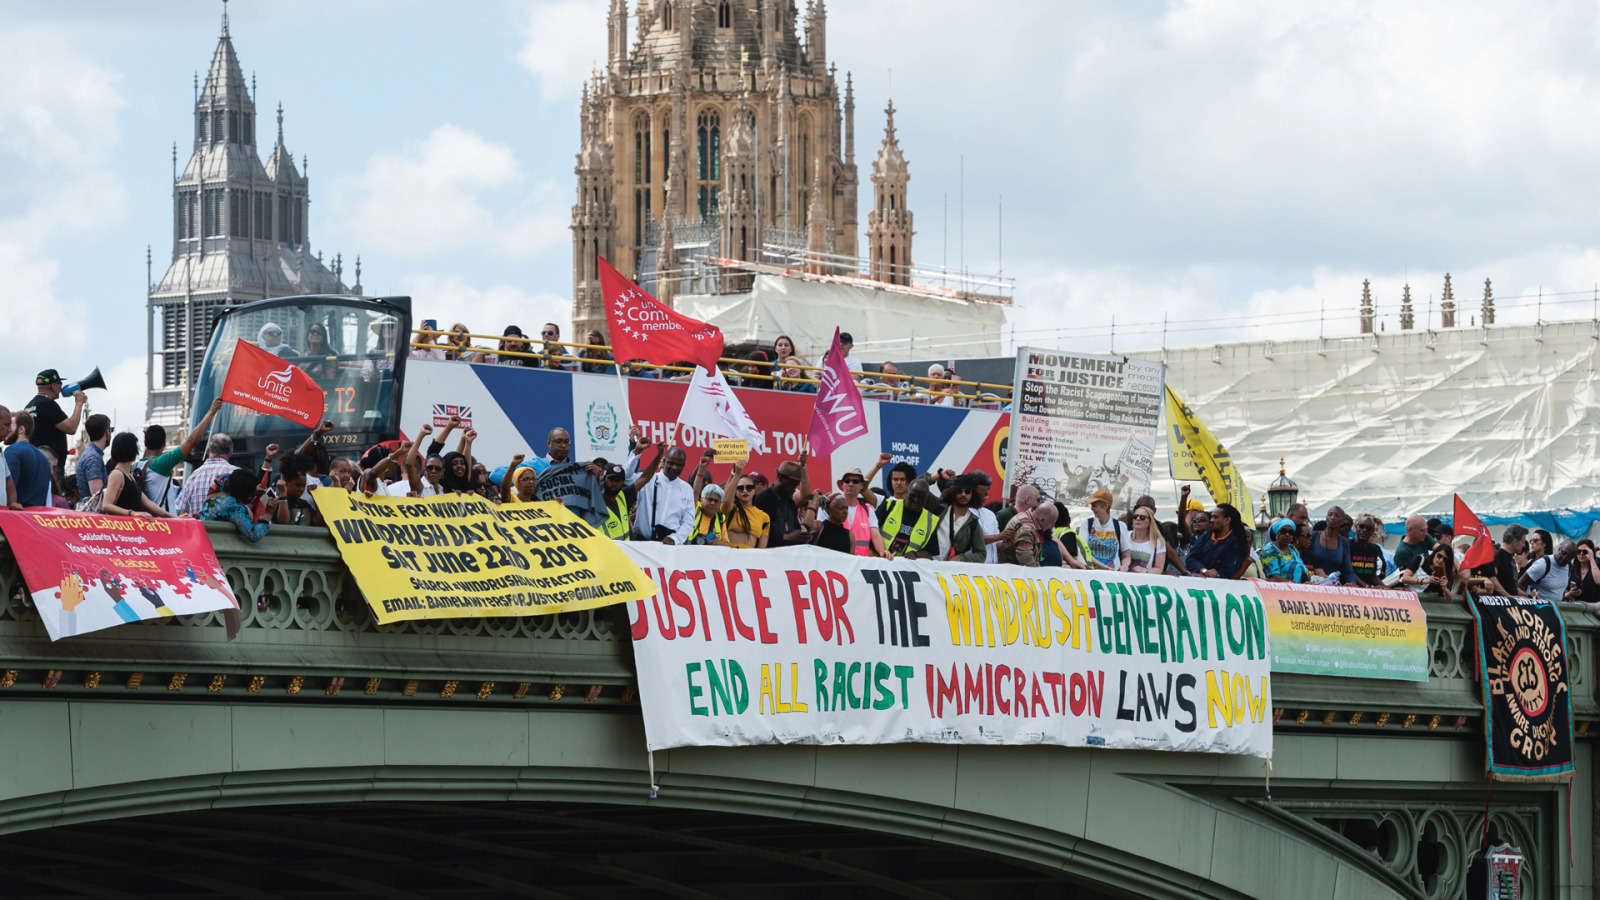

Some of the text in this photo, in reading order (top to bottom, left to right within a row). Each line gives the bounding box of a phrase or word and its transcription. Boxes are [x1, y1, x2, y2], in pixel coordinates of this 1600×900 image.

[1029, 353, 1160, 374] MOVEMENT by any
[258, 375, 292, 397] unite
[1028, 367, 1124, 388] FOR JUSTICE
[334, 387, 356, 412] T2
[1025, 382, 1044, 395] Stop
[1046, 384, 1058, 394] the
[1060, 386, 1084, 397] Racist
[1085, 388, 1129, 404] Scapegoating
[1130, 394, 1136, 402] of
[1023, 404, 1038, 412] Shut
[1039, 405, 1056, 413] Down
[1057, 407, 1084, 417] Detention
[1085, 411, 1105, 420] Centres
[1109, 413, 1120, 423] Stop
[1024, 394, 1042, 404] Open
[1058, 398, 1084, 407] Borders
[1115, 404, 1145, 414] Immigration
[1022, 416, 1049, 426] Building
[322, 435, 358, 444] YXY 792
[638, 420, 677, 446] THE
[772, 432, 816, 456] TOU
[1046, 427, 1078, 438] immigrant
[892, 442, 920, 453] HOP-ON
[890, 455, 920, 466] HOP-OFF
[540, 475, 575, 492] SOCIAL
[400, 504, 428, 519] FOR
[430, 500, 495, 518] WINDRUS
[33, 515, 171, 534] Dartford Labour Party
[448, 522, 492, 547] DAY
[78, 533, 112, 542] Solidarity
[119, 535, 147, 544] Strength
[65, 543, 88, 553] Your
[89, 545, 112, 555] Voice
[116, 546, 132, 556] For
[134, 547, 150, 556] Our
[151, 547, 183, 556] Future
[382, 545, 424, 572] SAT
[532, 543, 588, 570] 2019
[122, 558, 158, 568] Labour
[1290, 584, 1325, 594] WINDRUSH
[1326, 586, 1340, 595] DAY
[1350, 588, 1373, 597] ACTION
[1383, 590, 1398, 599] JUNE
[1399, 591, 1415, 600] 2019
[631, 567, 778, 644] JUSTICE
[785, 570, 855, 646] FOR
[860, 569, 930, 648] THE
[1278, 599, 1412, 623] BAME LAWYERS 4 JUSTICE
[1290, 618, 1407, 638] bamelawyersforjustice@gmail.com
[1514, 625, 1530, 642] AND
[1532, 630, 1560, 682] STRONG
[686, 658, 1267, 732] END ALL RACIST IMMIGRATION LAWS NOW
[1518, 690, 1544, 711] UNITY
[1506, 693, 1529, 734] AWARE
